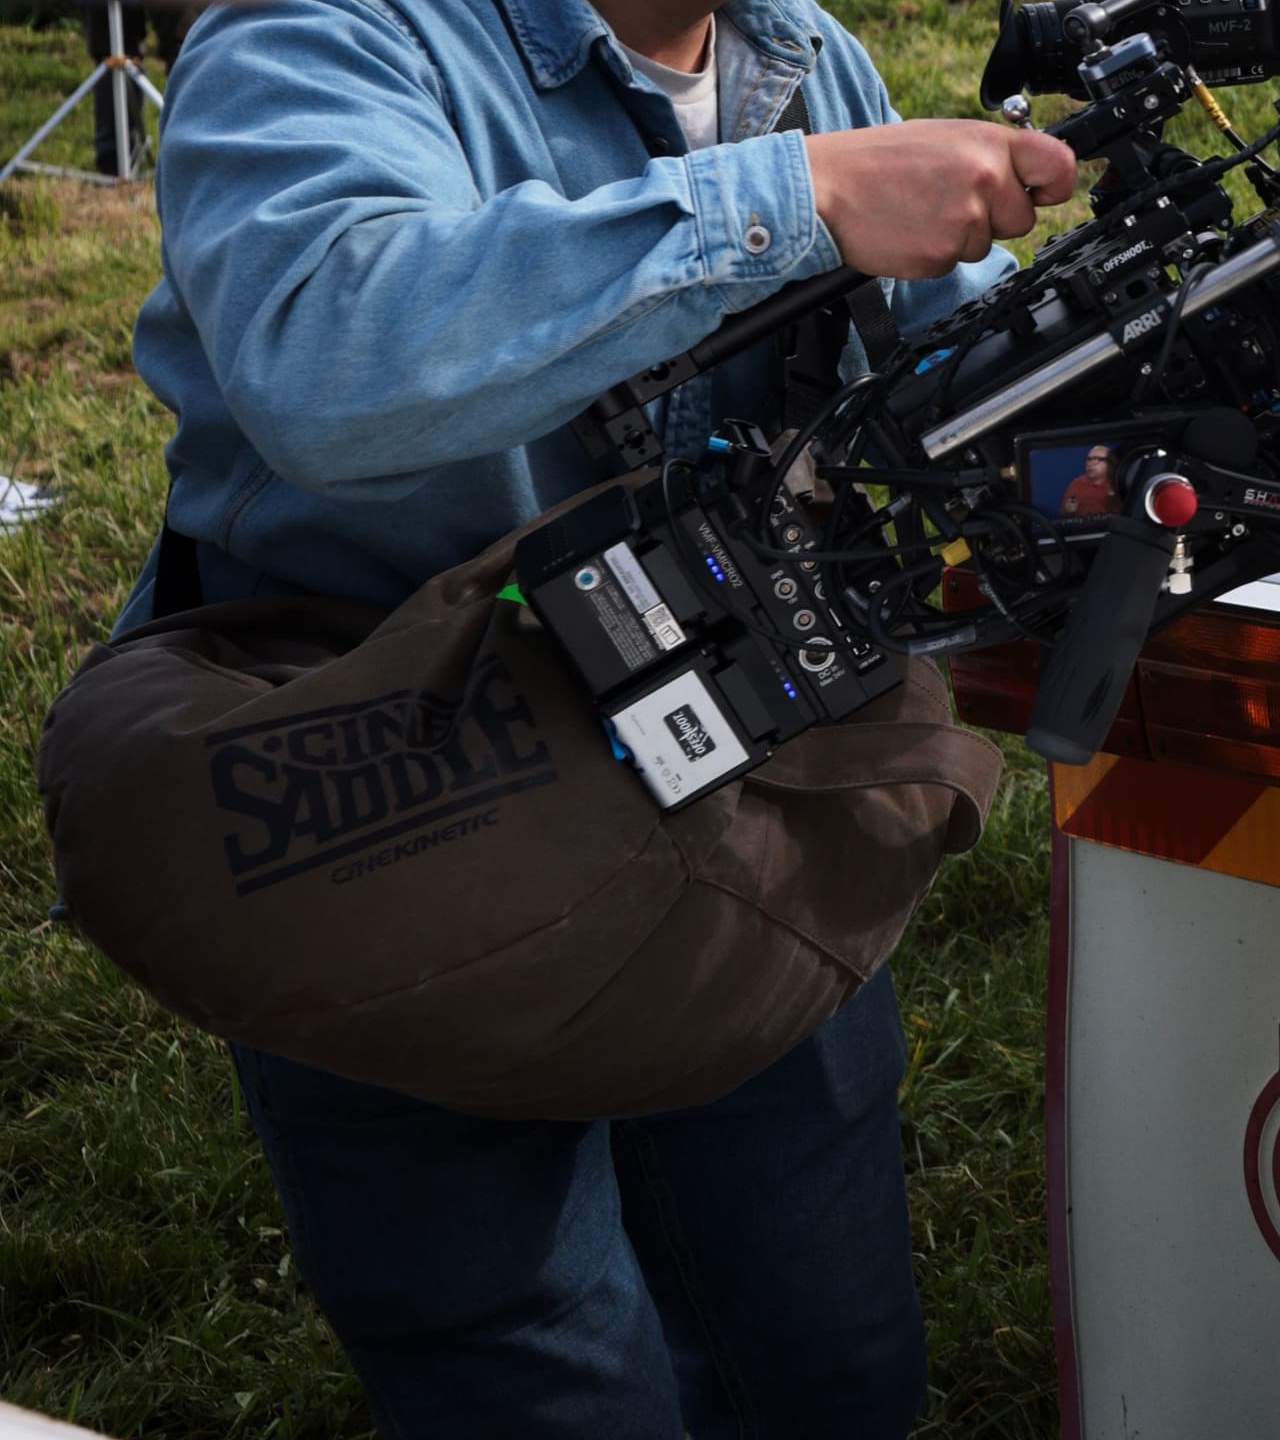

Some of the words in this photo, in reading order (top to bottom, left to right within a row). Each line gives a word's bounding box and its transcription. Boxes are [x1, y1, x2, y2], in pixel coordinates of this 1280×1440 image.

[1208, 18, 1252, 35] MVF-2
[1122, 309, 1163, 345] ARRI
[209, 654, 552, 875] SADDLE
[287, 701, 456, 765] CINE
[330, 808, 499, 884] CINEKINETIC
